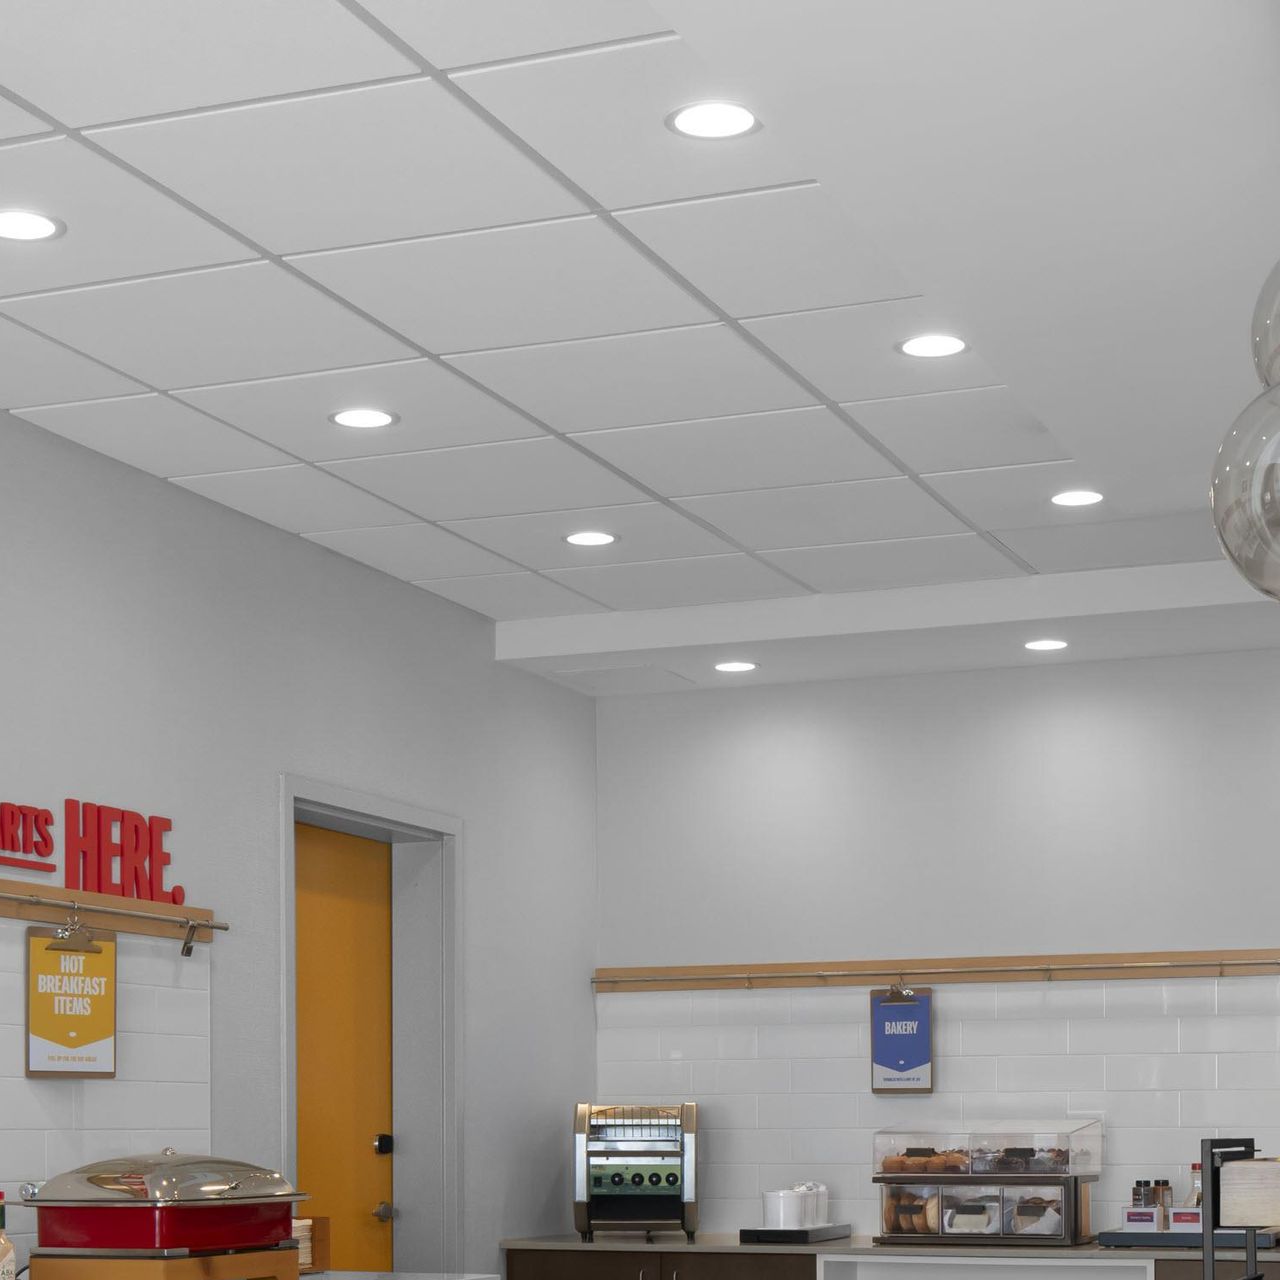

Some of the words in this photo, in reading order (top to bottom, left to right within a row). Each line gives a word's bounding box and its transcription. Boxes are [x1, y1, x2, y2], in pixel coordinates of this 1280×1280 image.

[64, 798, 186, 906] HERE.
[60, 954, 86, 974] HOT
[37, 974, 107, 996] BREAKFAST
[53, 995, 92, 1016] ITEMS
[884, 1021, 919, 1035] BAKERY
